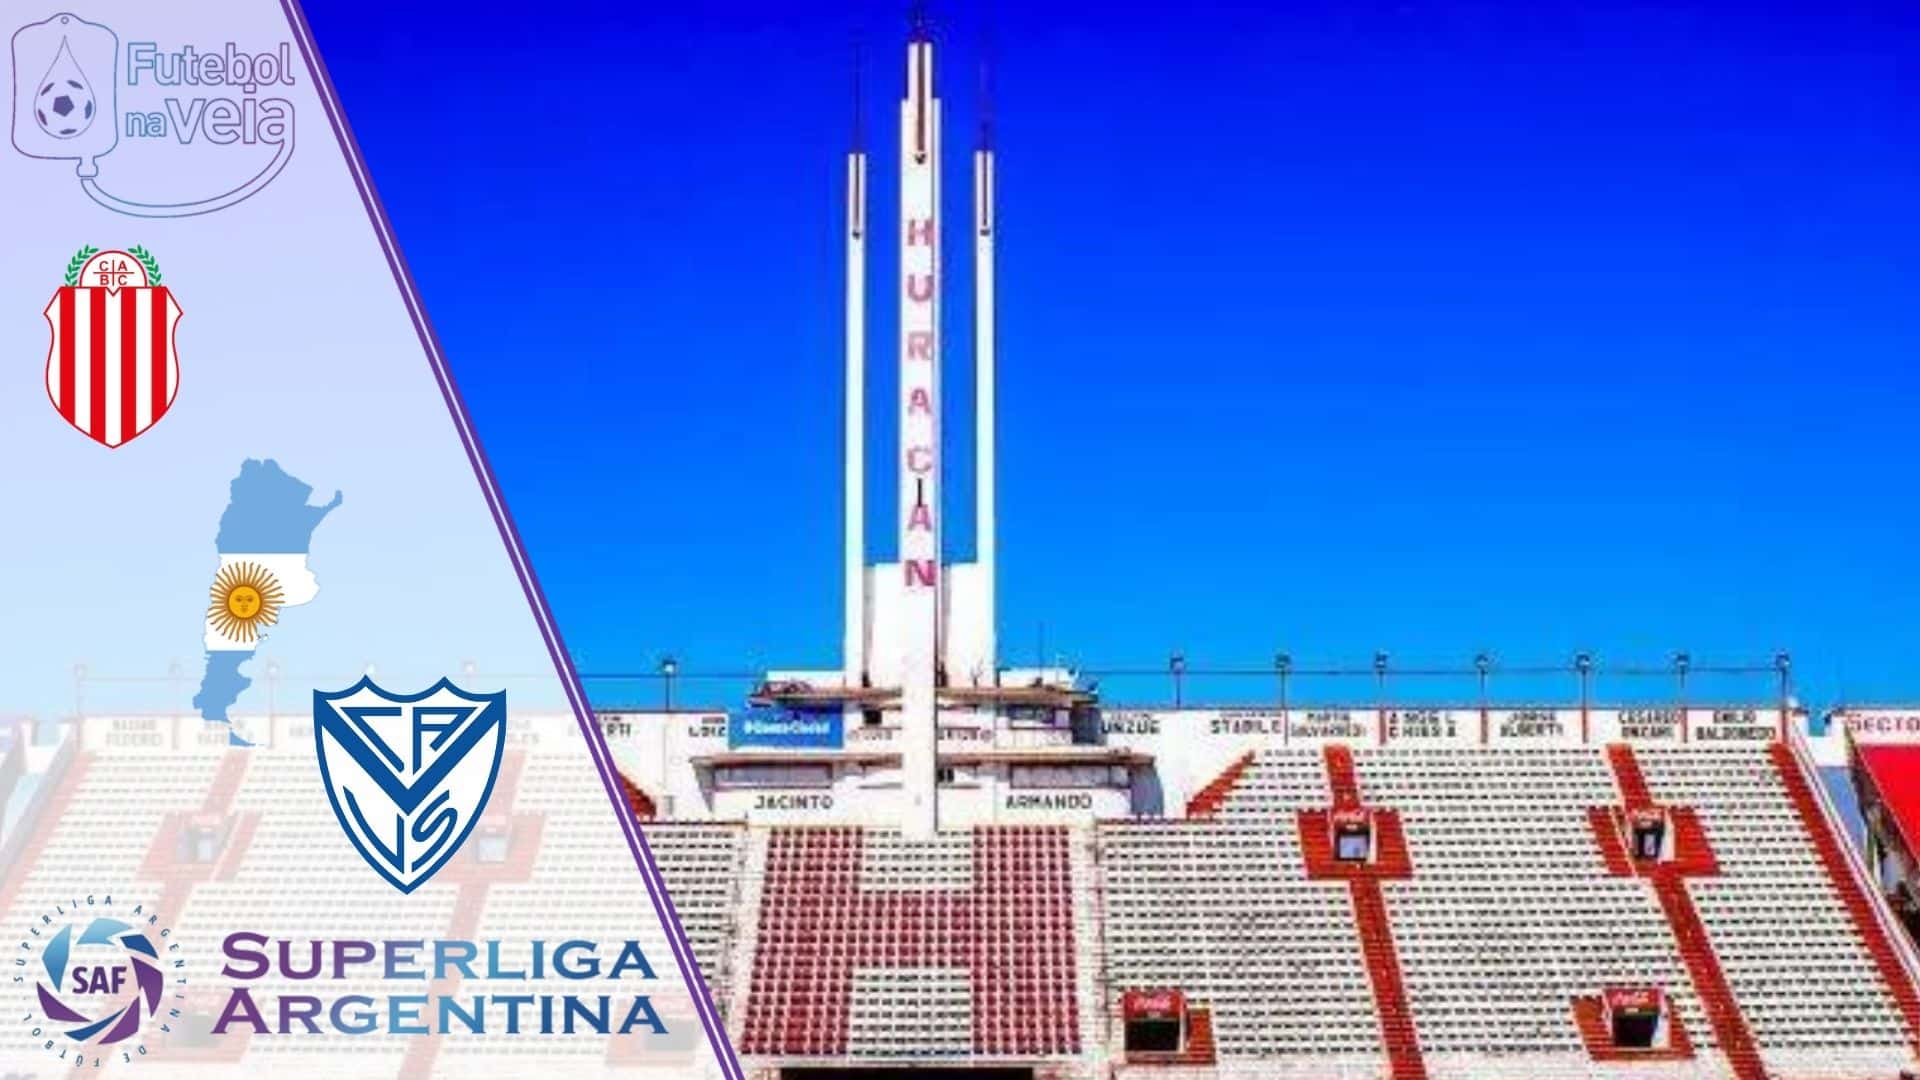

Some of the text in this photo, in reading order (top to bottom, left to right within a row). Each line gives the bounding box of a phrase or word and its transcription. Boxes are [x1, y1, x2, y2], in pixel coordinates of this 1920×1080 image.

[1101, 720, 1161, 735] UNZUE
[754, 794, 1093, 811] JACINTO ARMANDO
